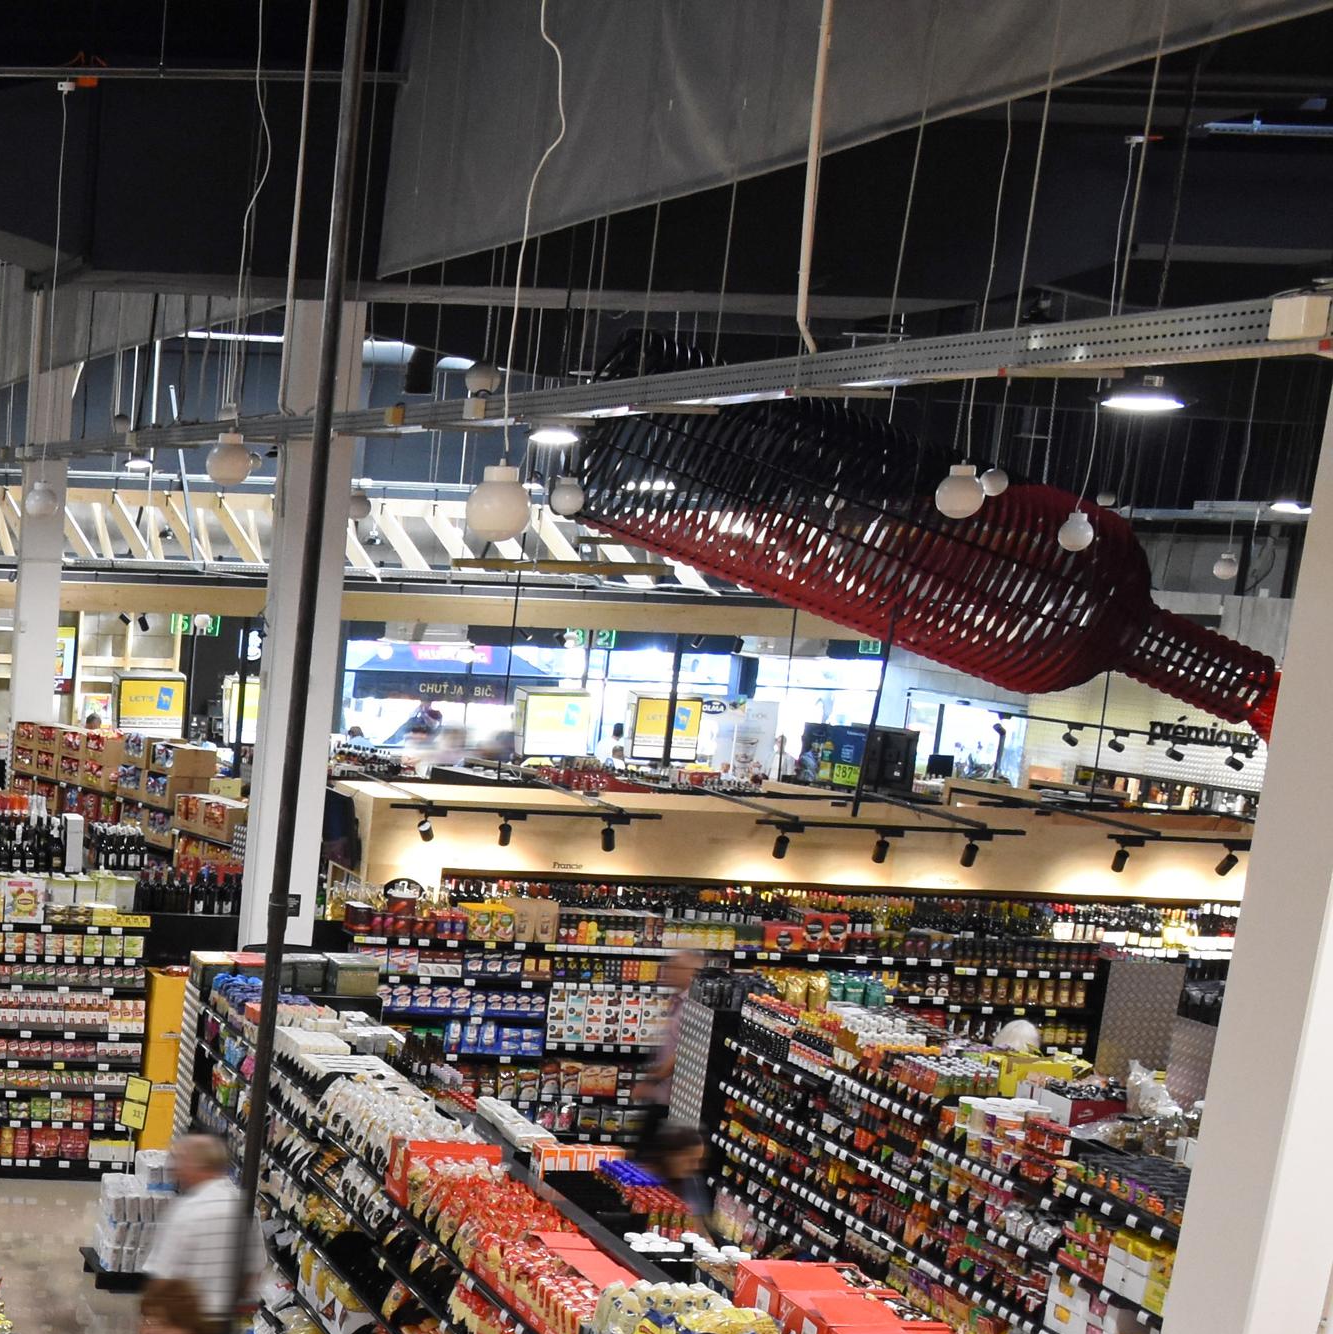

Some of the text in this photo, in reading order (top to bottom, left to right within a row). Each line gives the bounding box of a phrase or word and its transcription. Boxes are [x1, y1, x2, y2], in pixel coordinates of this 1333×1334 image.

[597, 631, 612, 646] 2
[419, 681, 447, 694] CHUŤ
[701, 704, 724, 713] OLMA
